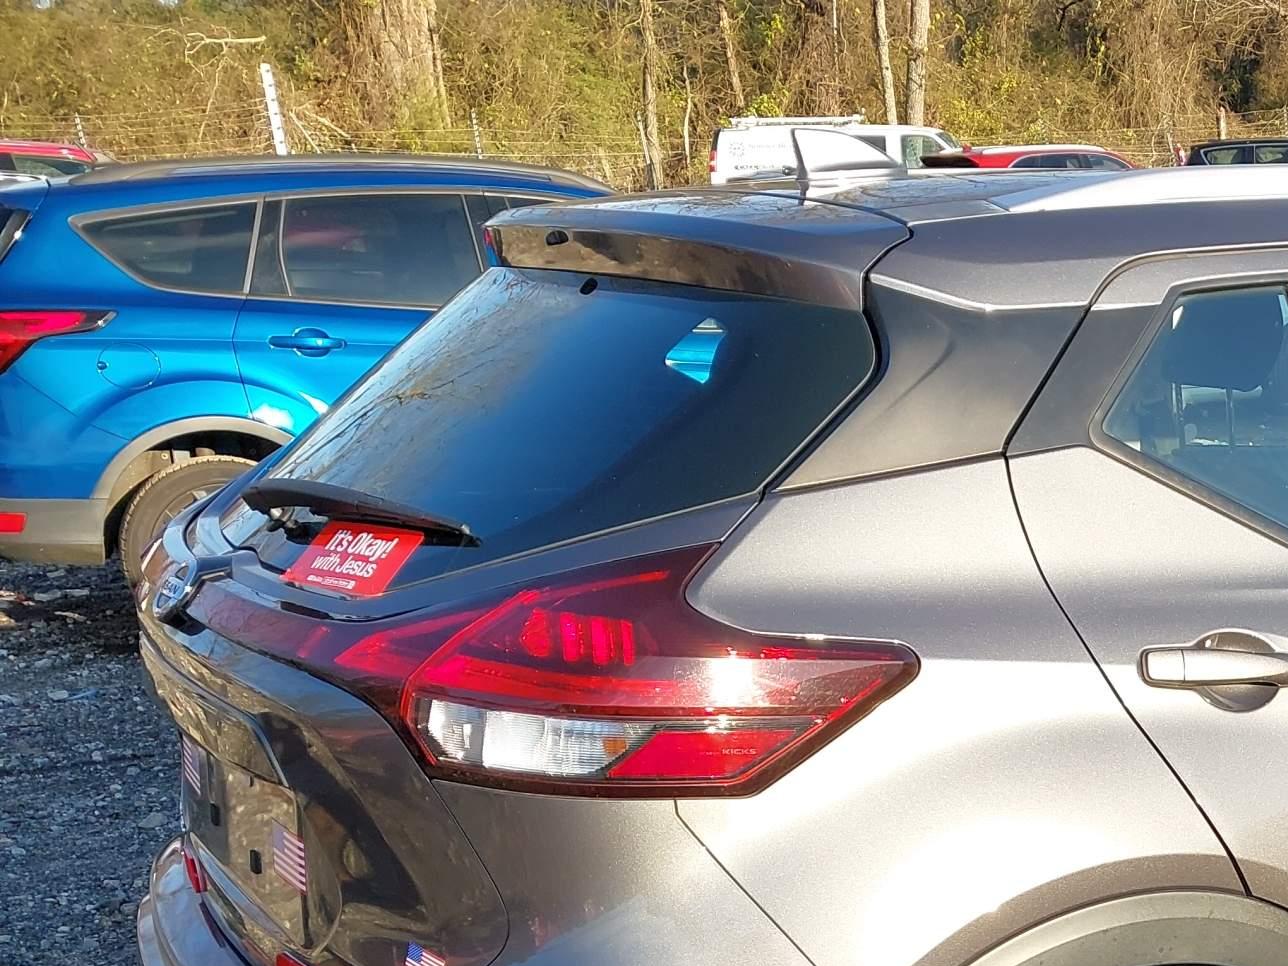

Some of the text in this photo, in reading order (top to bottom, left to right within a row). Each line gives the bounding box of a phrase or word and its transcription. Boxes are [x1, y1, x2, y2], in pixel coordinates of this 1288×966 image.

[347, 532, 400, 562] Okay!
[311, 552, 377, 578] with Jesus
